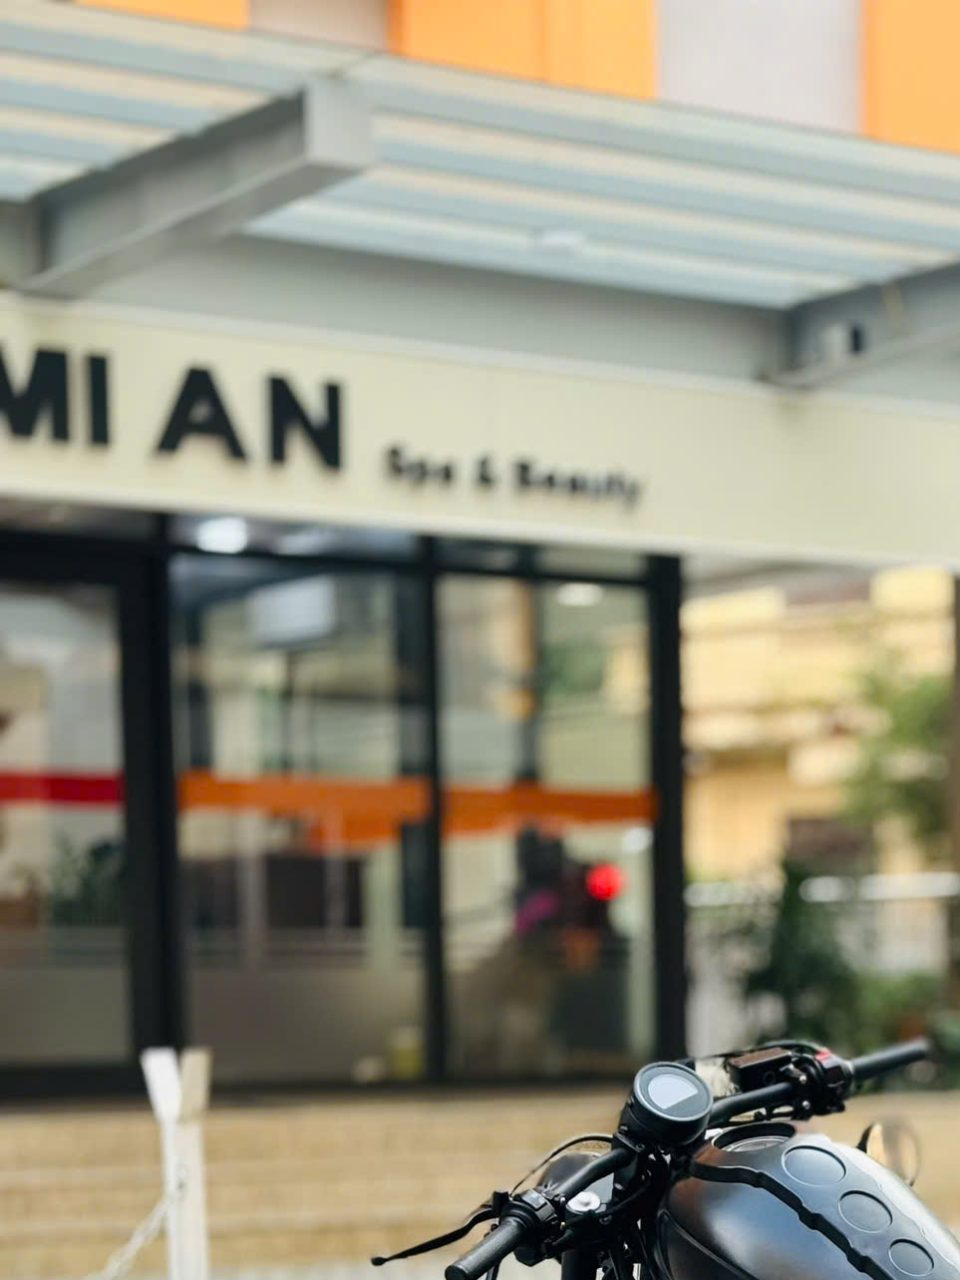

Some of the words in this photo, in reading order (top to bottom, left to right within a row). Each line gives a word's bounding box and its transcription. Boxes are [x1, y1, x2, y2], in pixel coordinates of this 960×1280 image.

[154, 365, 344, 471] AN
[384, 445, 454, 490] Spa
[474, 454, 498, 489] &
[515, 460, 643, 510] Beauty
